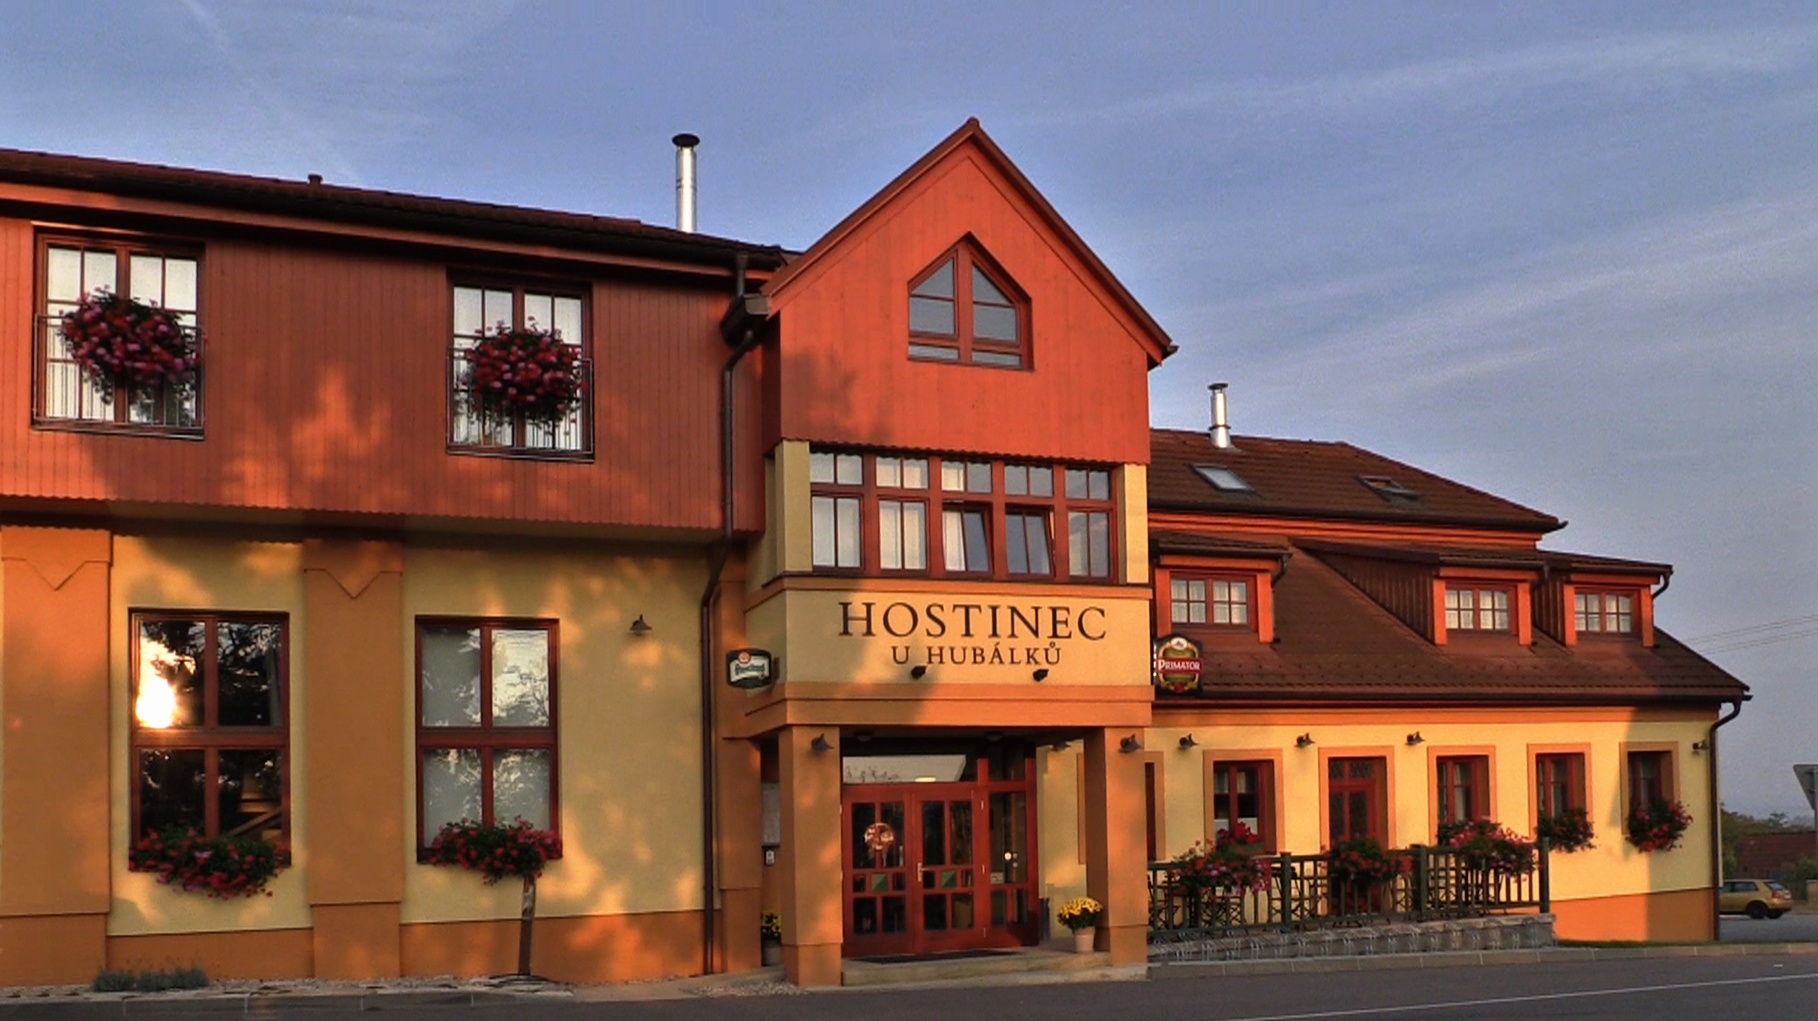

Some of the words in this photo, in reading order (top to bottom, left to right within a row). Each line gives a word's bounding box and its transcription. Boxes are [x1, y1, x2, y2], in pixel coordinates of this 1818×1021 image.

[838, 602, 1107, 640] HOSTINEC
[891, 646, 910, 665] U
[926, 641, 1062, 665] HUBÁLKŮ
